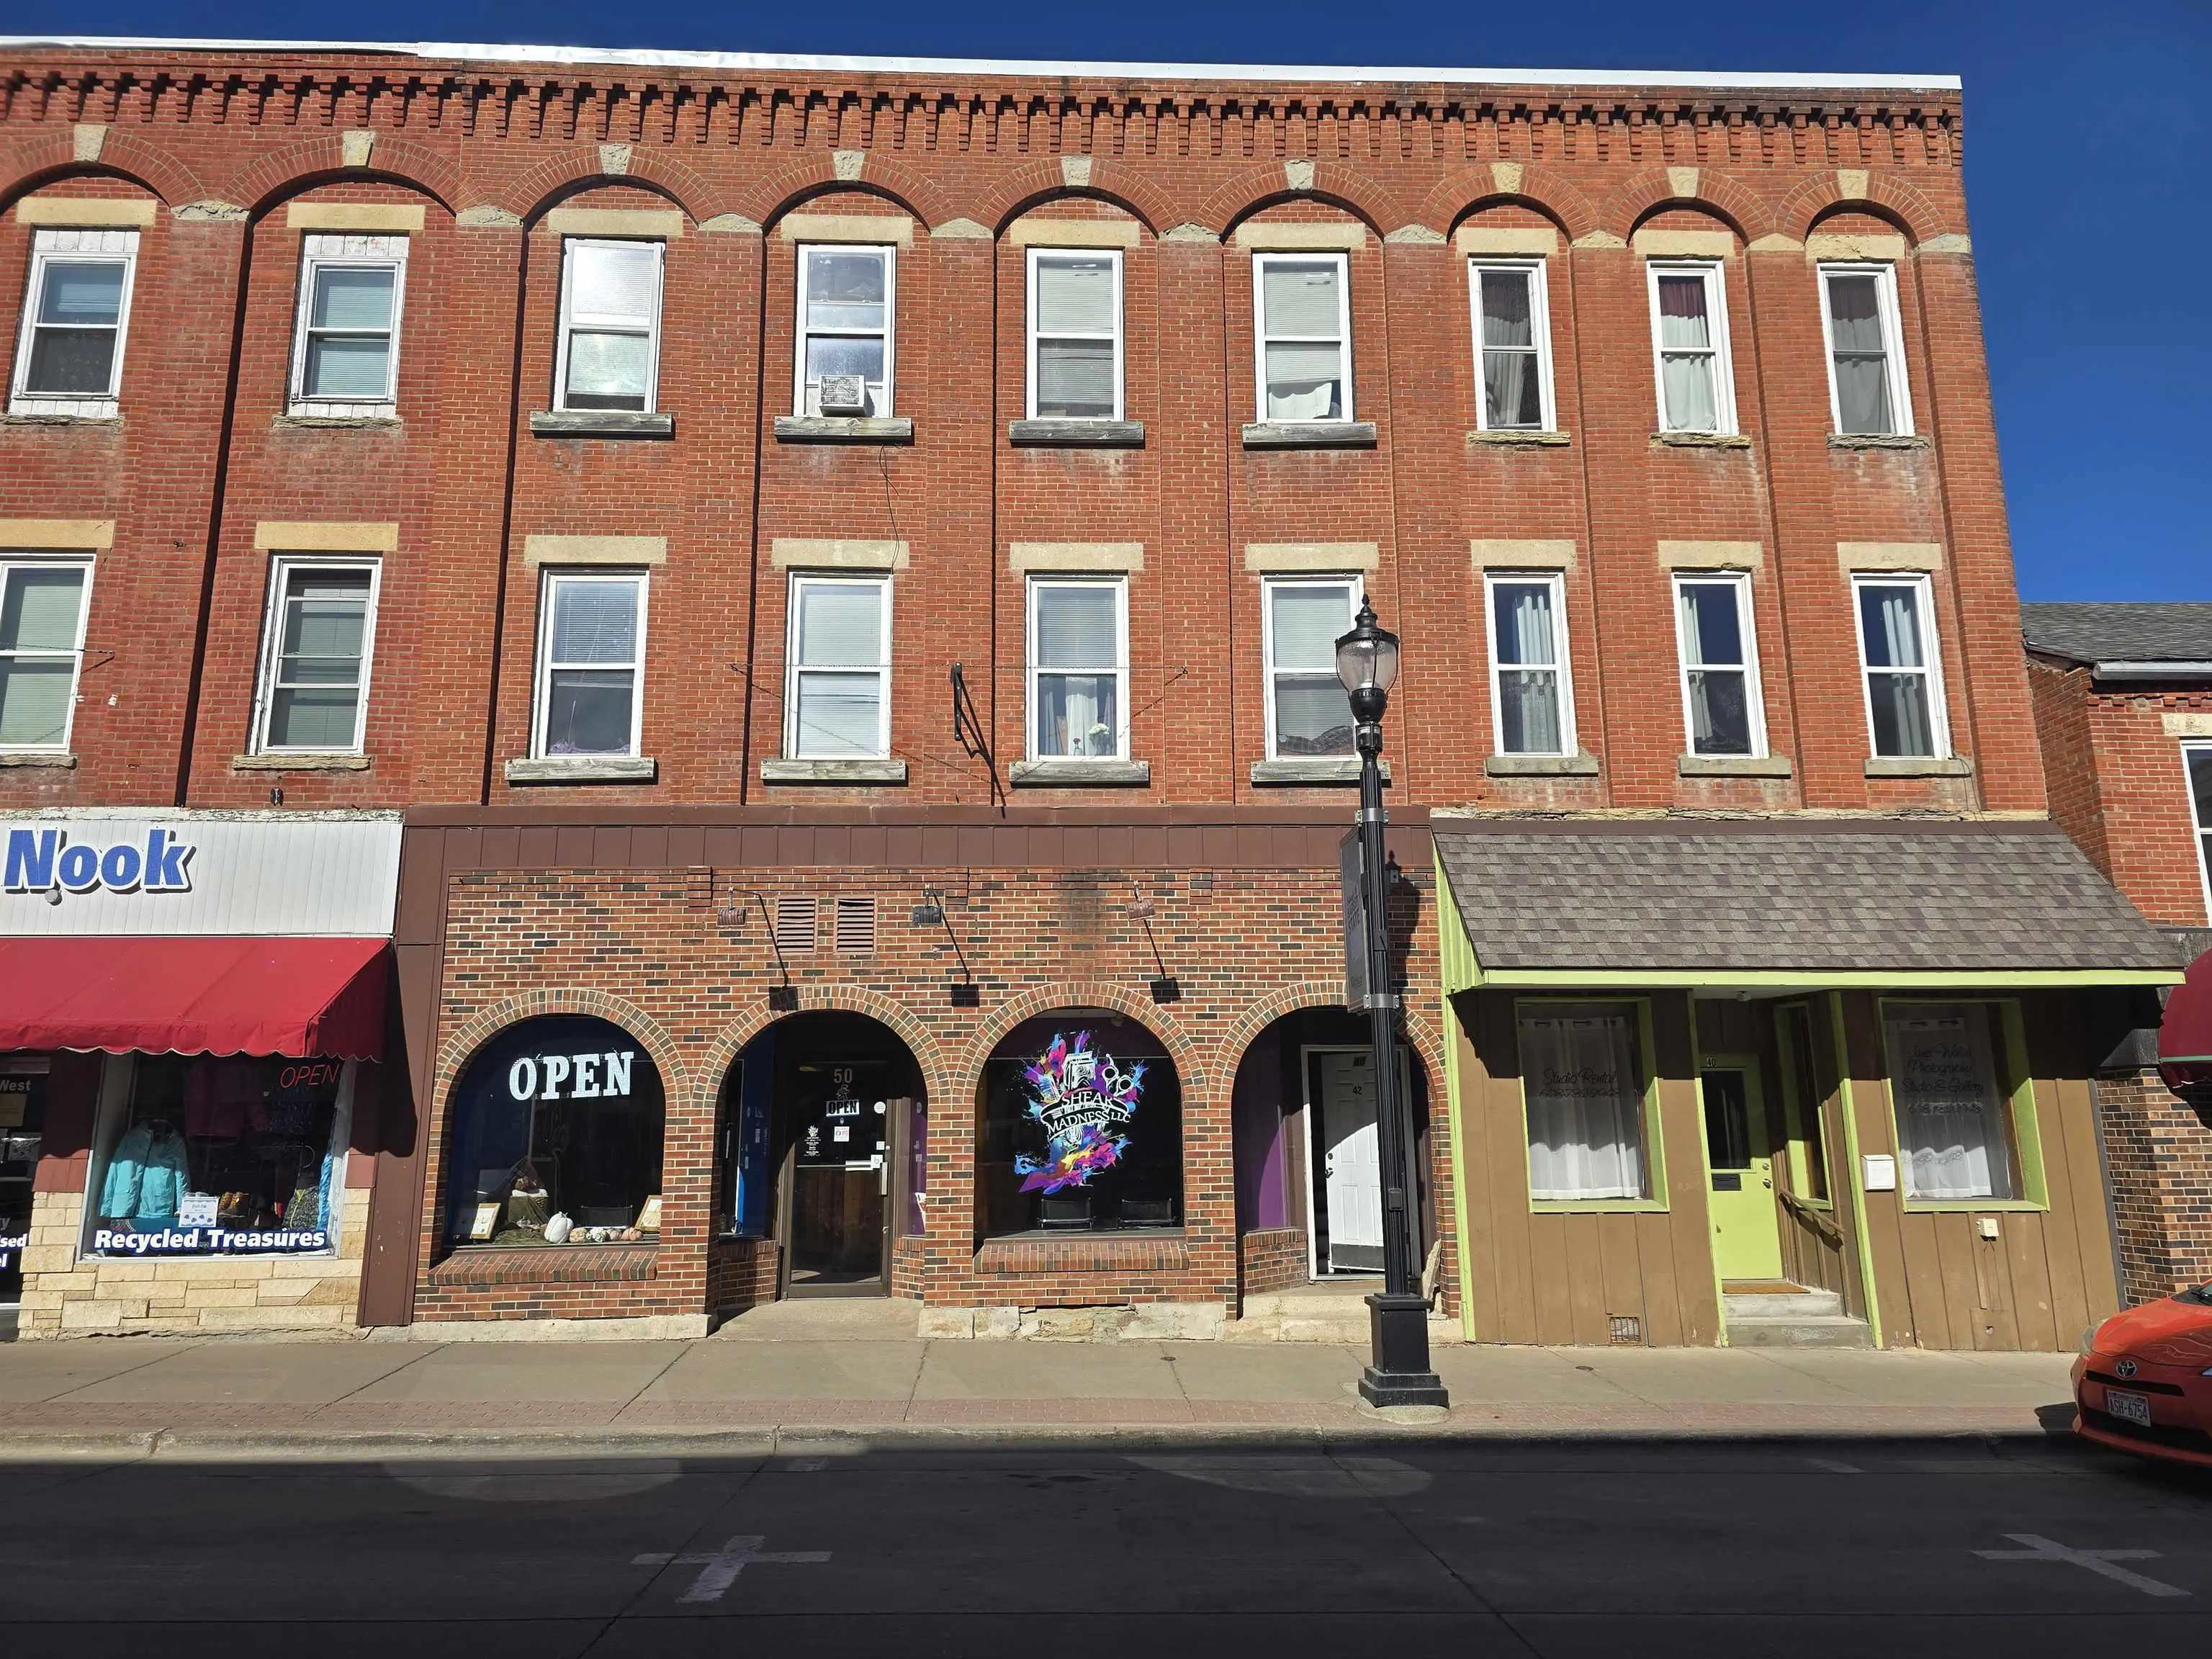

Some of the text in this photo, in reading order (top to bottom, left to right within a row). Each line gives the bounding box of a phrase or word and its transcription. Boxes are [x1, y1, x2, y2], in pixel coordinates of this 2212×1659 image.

[2, 827, 190, 890] Nook
[280, 1064, 340, 1088] OPEN
[509, 1052, 634, 1100] OPEN
[834, 1069, 853, 1084] 50
[1543, 1068, 1617, 1084] Studio Rental
[1353, 1085, 1362, 1095] 42
[1061, 1091, 1113, 1107] SHEAR
[828, 1100, 858, 1115] OPEN
[1046, 1110, 1131, 1134] MADNESS LLC
[0, 1233, 28, 1248] sed
[94, 1228, 325, 1254] Recycled Treasures
